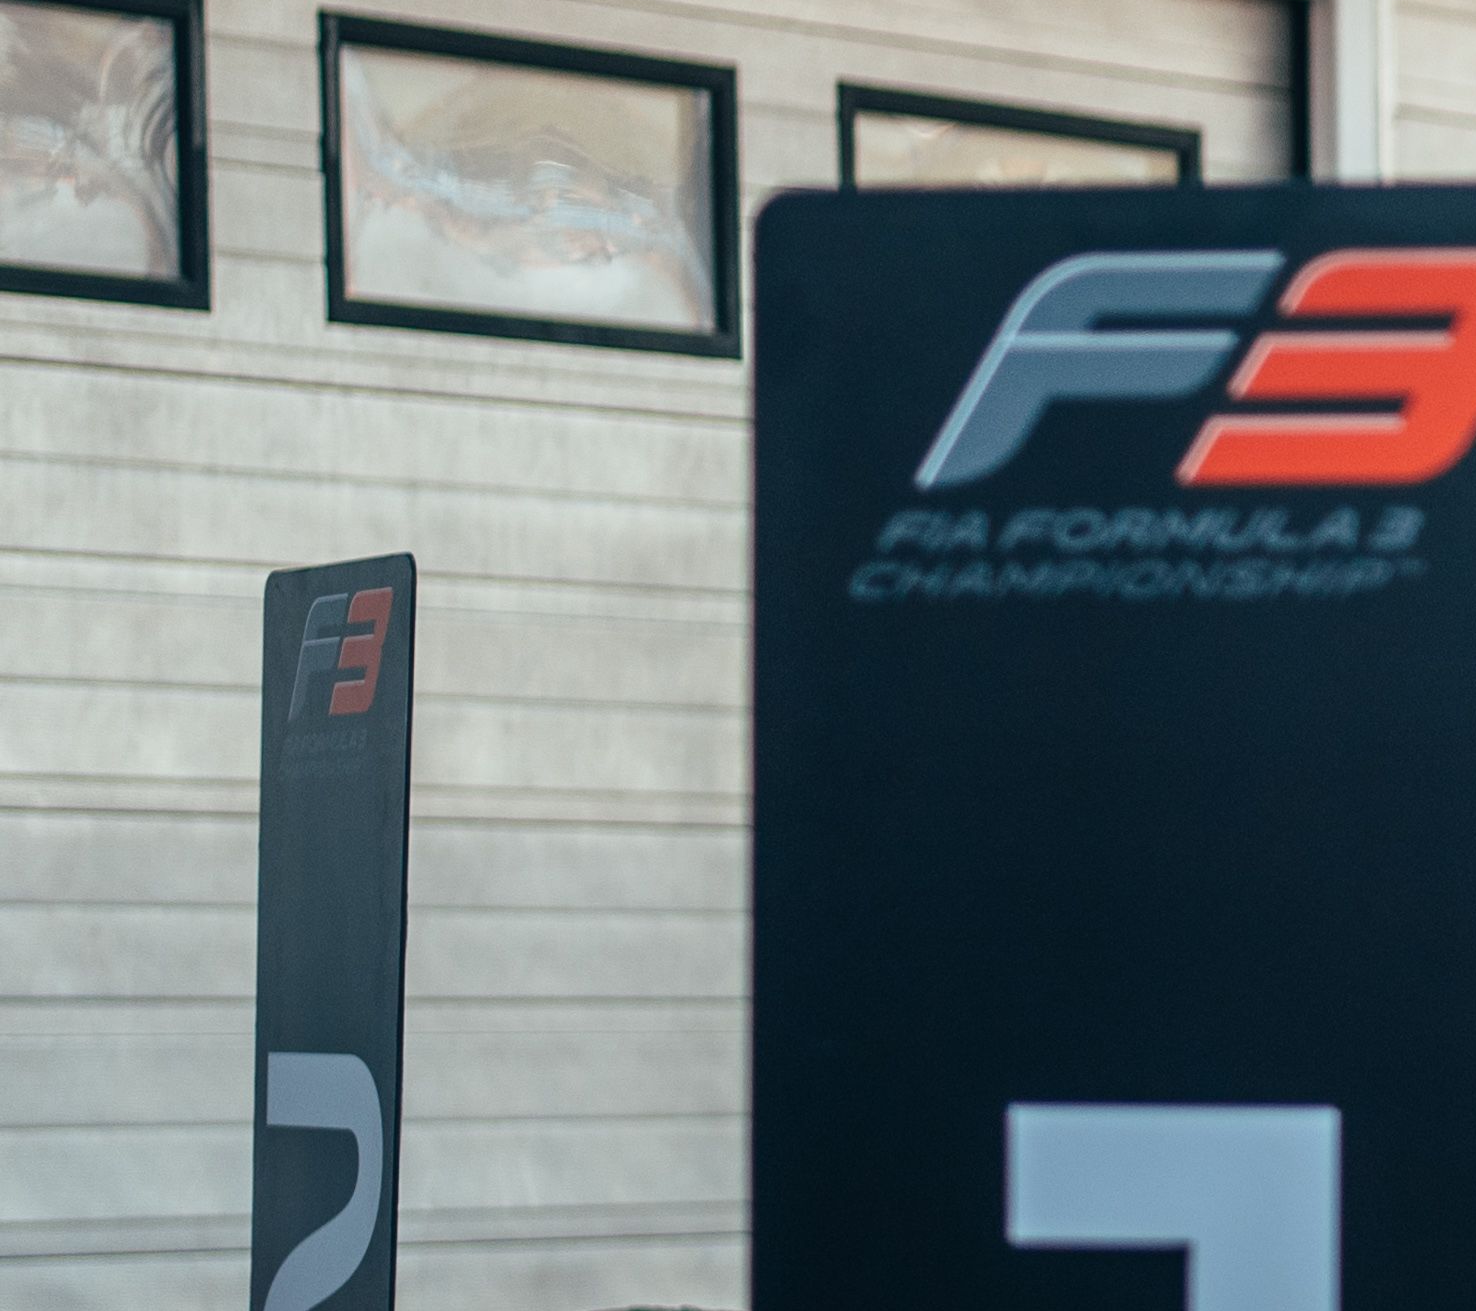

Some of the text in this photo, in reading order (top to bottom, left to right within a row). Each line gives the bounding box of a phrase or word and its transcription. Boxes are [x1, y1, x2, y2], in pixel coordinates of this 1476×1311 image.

[999, 507, 1361, 551] FORMULA
[848, 561, 1395, 602] CHAMPIONSHIP
[288, 586, 393, 722] F3
